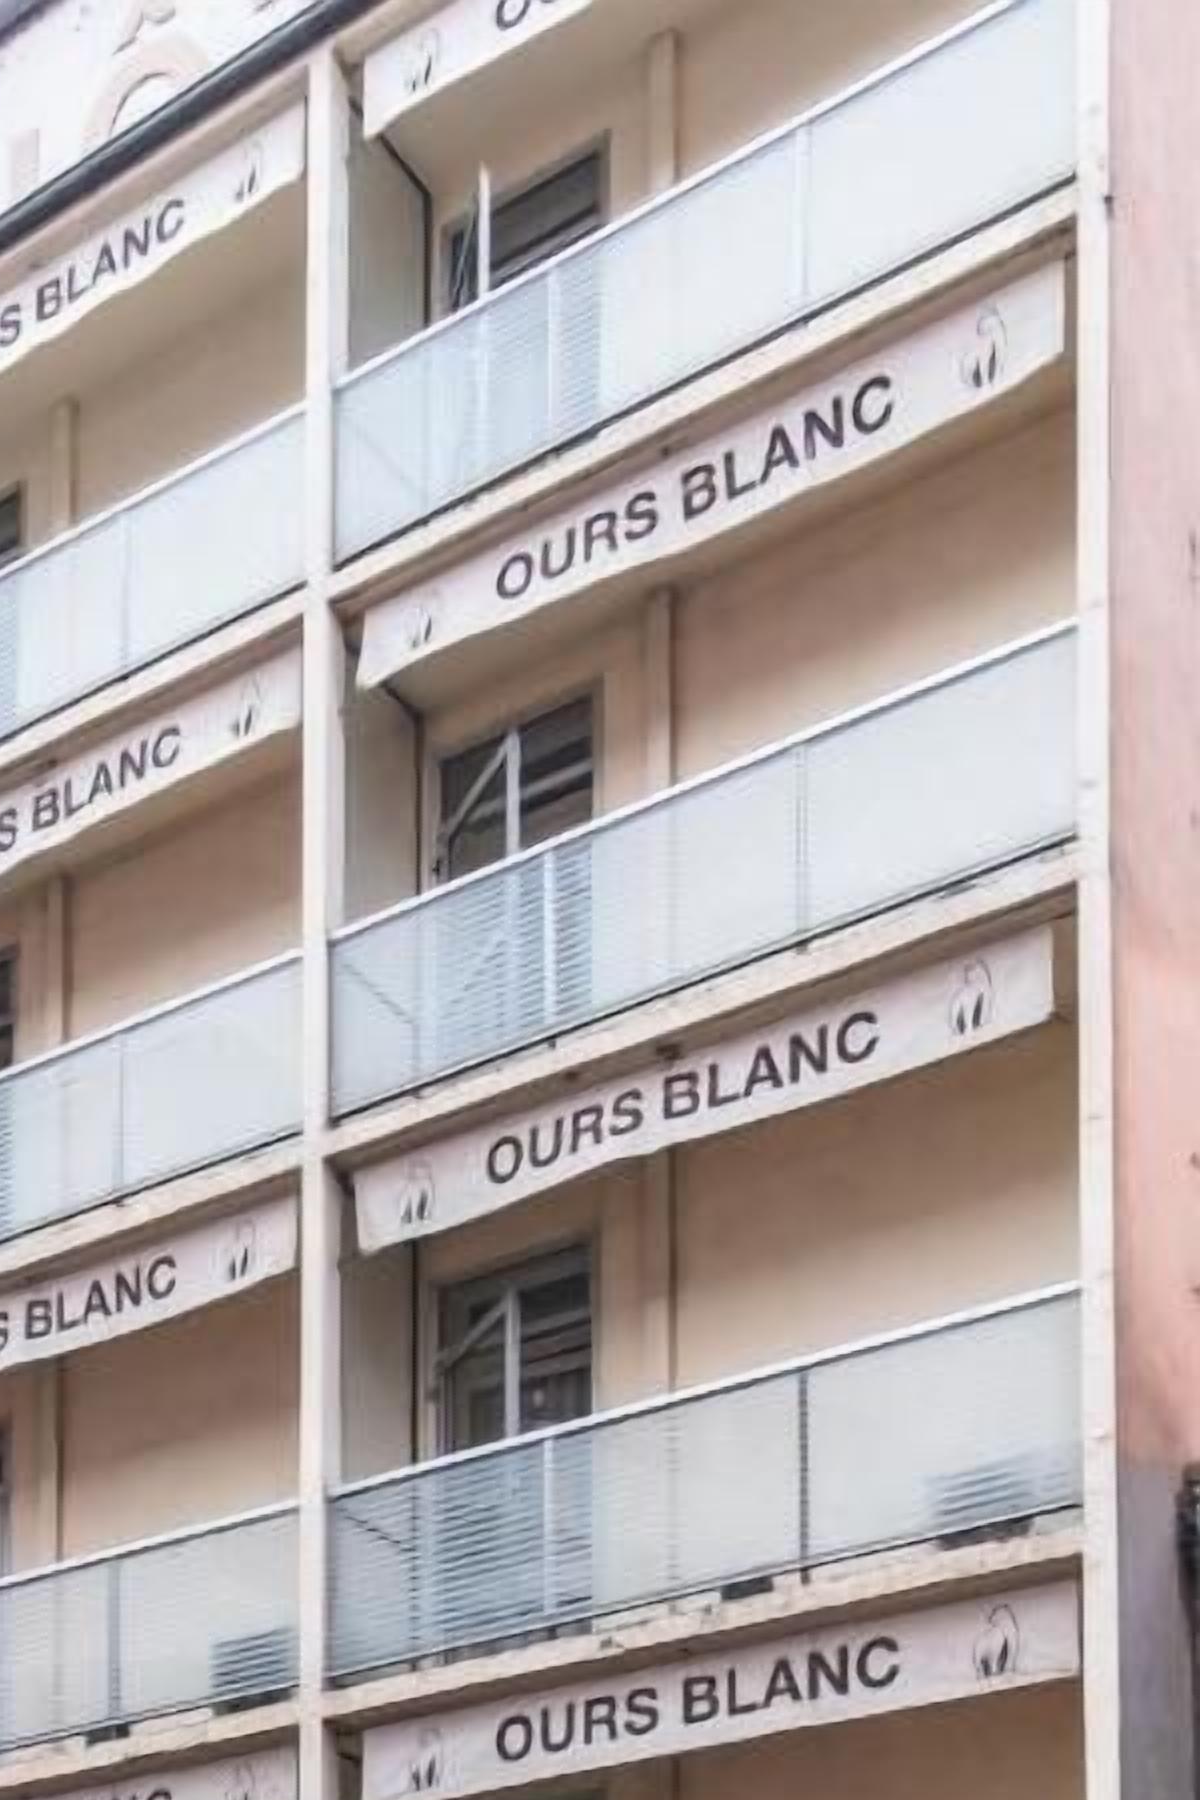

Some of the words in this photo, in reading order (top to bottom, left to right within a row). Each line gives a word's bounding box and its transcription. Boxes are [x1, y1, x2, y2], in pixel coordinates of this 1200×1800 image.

[35, 199, 185, 322] BLANC
[495, 490, 659, 600] OURS
[682, 376, 894, 519] BLANC
[32, 726, 181, 832] BLANC
[486, 1088, 643, 1184] OURS
[662, 1011, 879, 1119] BLANC
[25, 1256, 176, 1339] BLANC
[495, 1686, 659, 1761] OURS
[682, 1636, 899, 1724] BLANC
